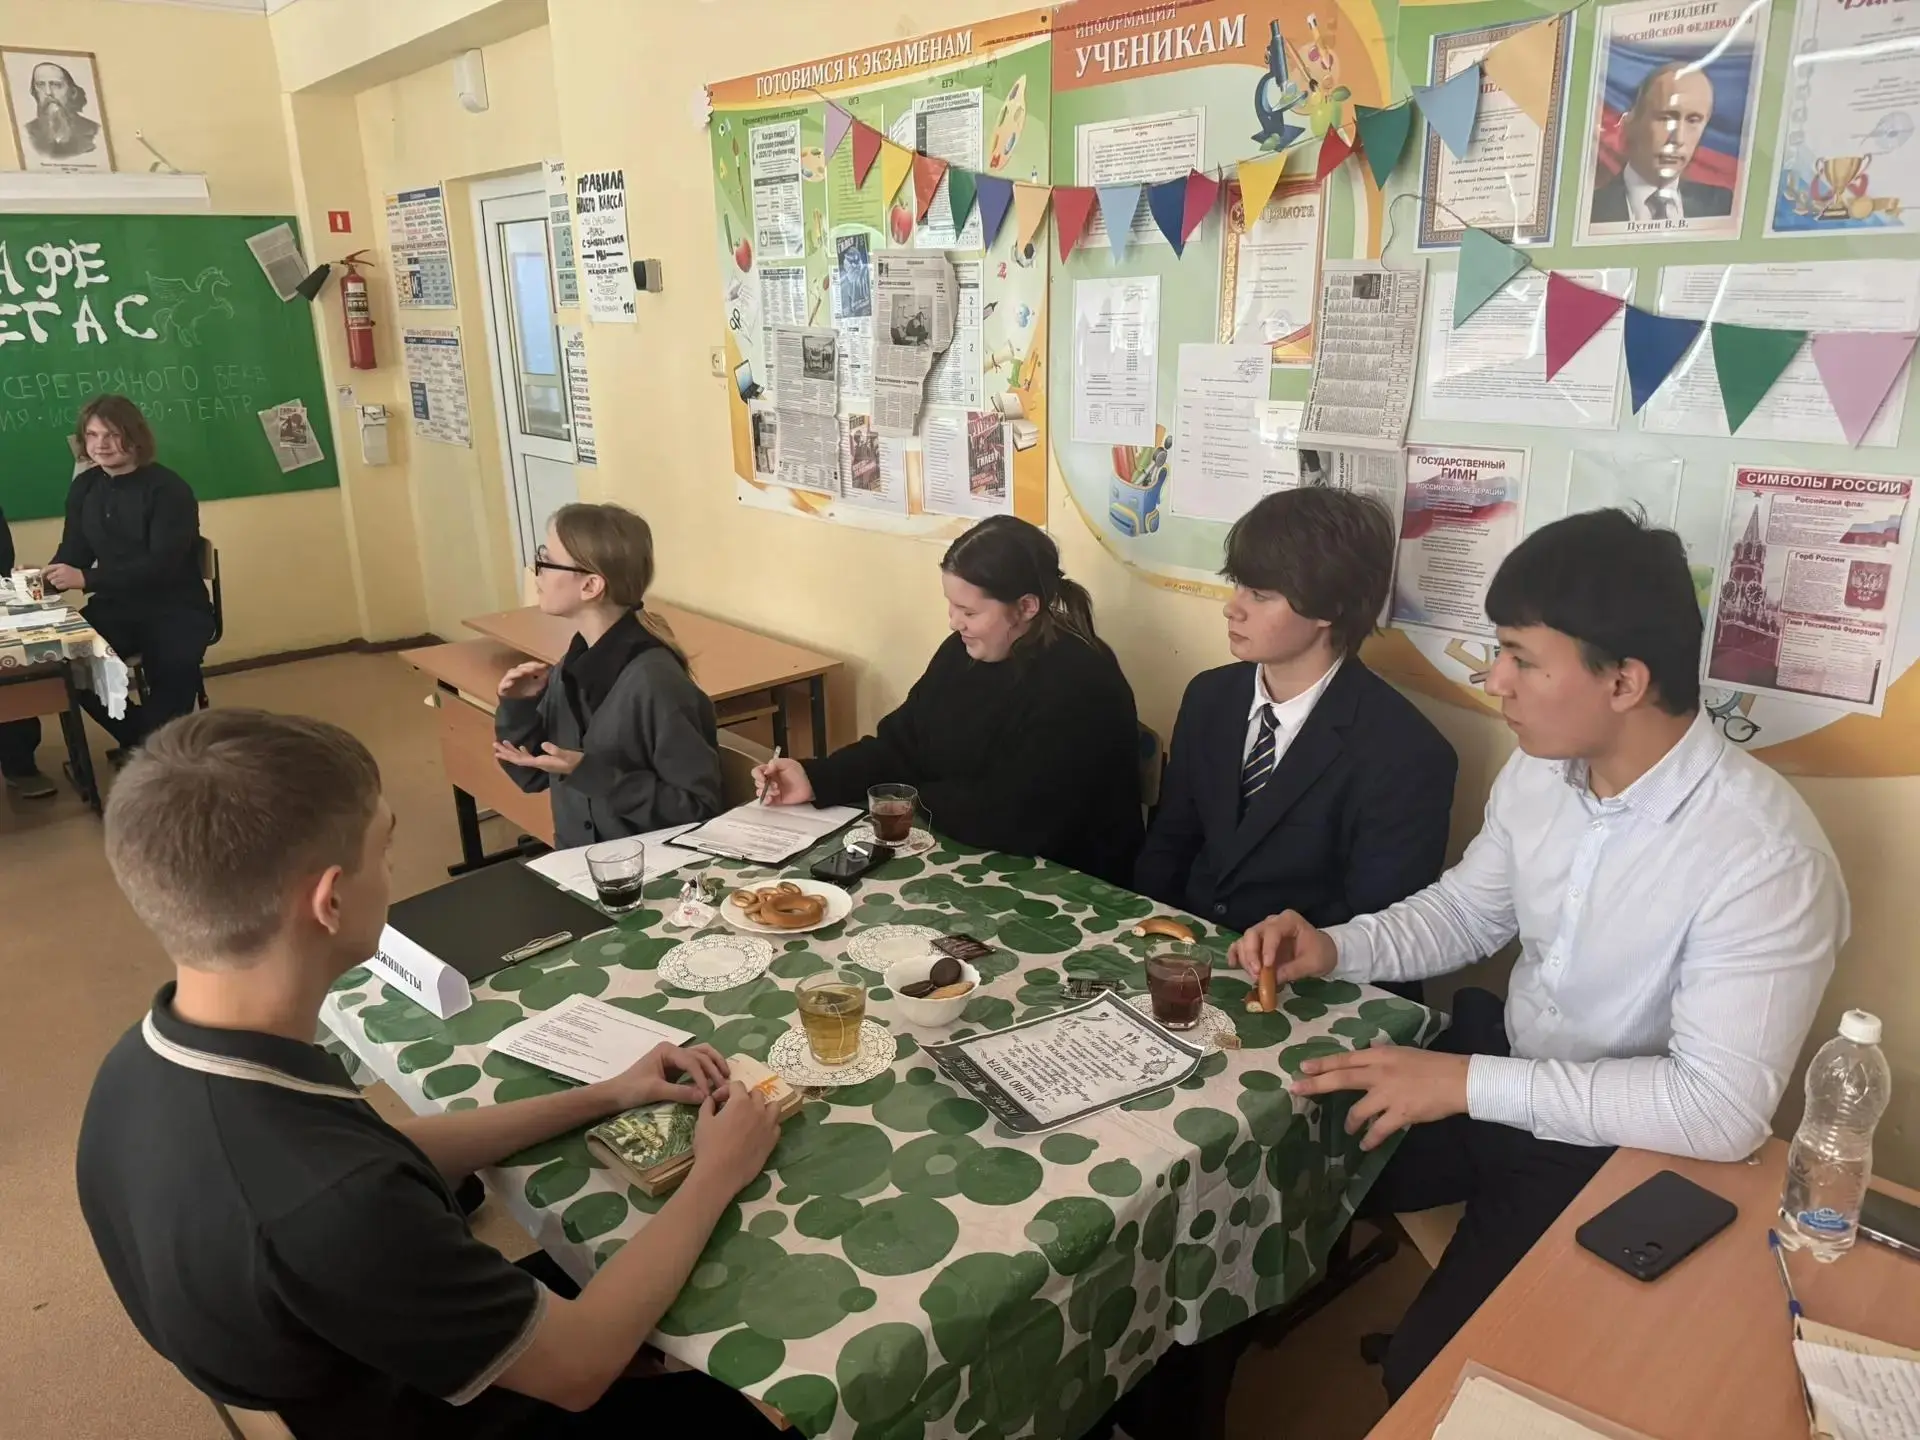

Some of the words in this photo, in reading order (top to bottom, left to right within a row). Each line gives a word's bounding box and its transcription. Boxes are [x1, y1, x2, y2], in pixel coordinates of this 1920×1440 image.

[1075, 1, 1176, 39] ИНФОРМАЦИЯ
[1648, 2, 1718, 23] ПРЕЗИДЕНТ
[1617, 23, 1684, 41] ОССИЙСКОЙ
[1687, 15, 1753, 33] ФЕДЕРАЦИ
[1075, 13, 1247, 78] УЧЕНИКАМ
[755, 58, 845, 99] ГОТОВИМСЯ
[847, 55, 861, 80] К
[863, 29, 974, 75] ЭКЗАМЕНАМ
[941, 78, 953, 88] ЕГЭ
[577, 170, 625, 195] ПРАВИЛА
[599, 192, 623, 213] КЛАССА
[1627, 219, 1661, 232] Путин
[1664, 219, 1675, 230] В.
[1677, 218, 1689, 230] В.
[3, 365, 199, 400] СЕРЕБРЯНОГО
[175, 395, 253, 423] ТЕАТР
[1416, 456, 1505, 470] ГОСУДАРСТВЕННЫЙ
[1441, 468, 1478, 481] ГИМН
[1746, 472, 1827, 489] СИМВОЛЫ
[1831, 478, 1901, 494] РОССИИ
[1795, 495, 1842, 507] Российский
[1844, 499, 1864, 509] флаг
[1795, 551, 1814, 562] Герб
[1815, 554, 1846, 564] России
[1803, 620, 1842, 632] Российской
[1844, 625, 1880, 637] Федерации
[985, 1058, 1016, 1081] ПОЭТА
[1007, 1079, 1044, 1105] МЕНЮ
[990, 1094, 1020, 1117] КАФЕ
